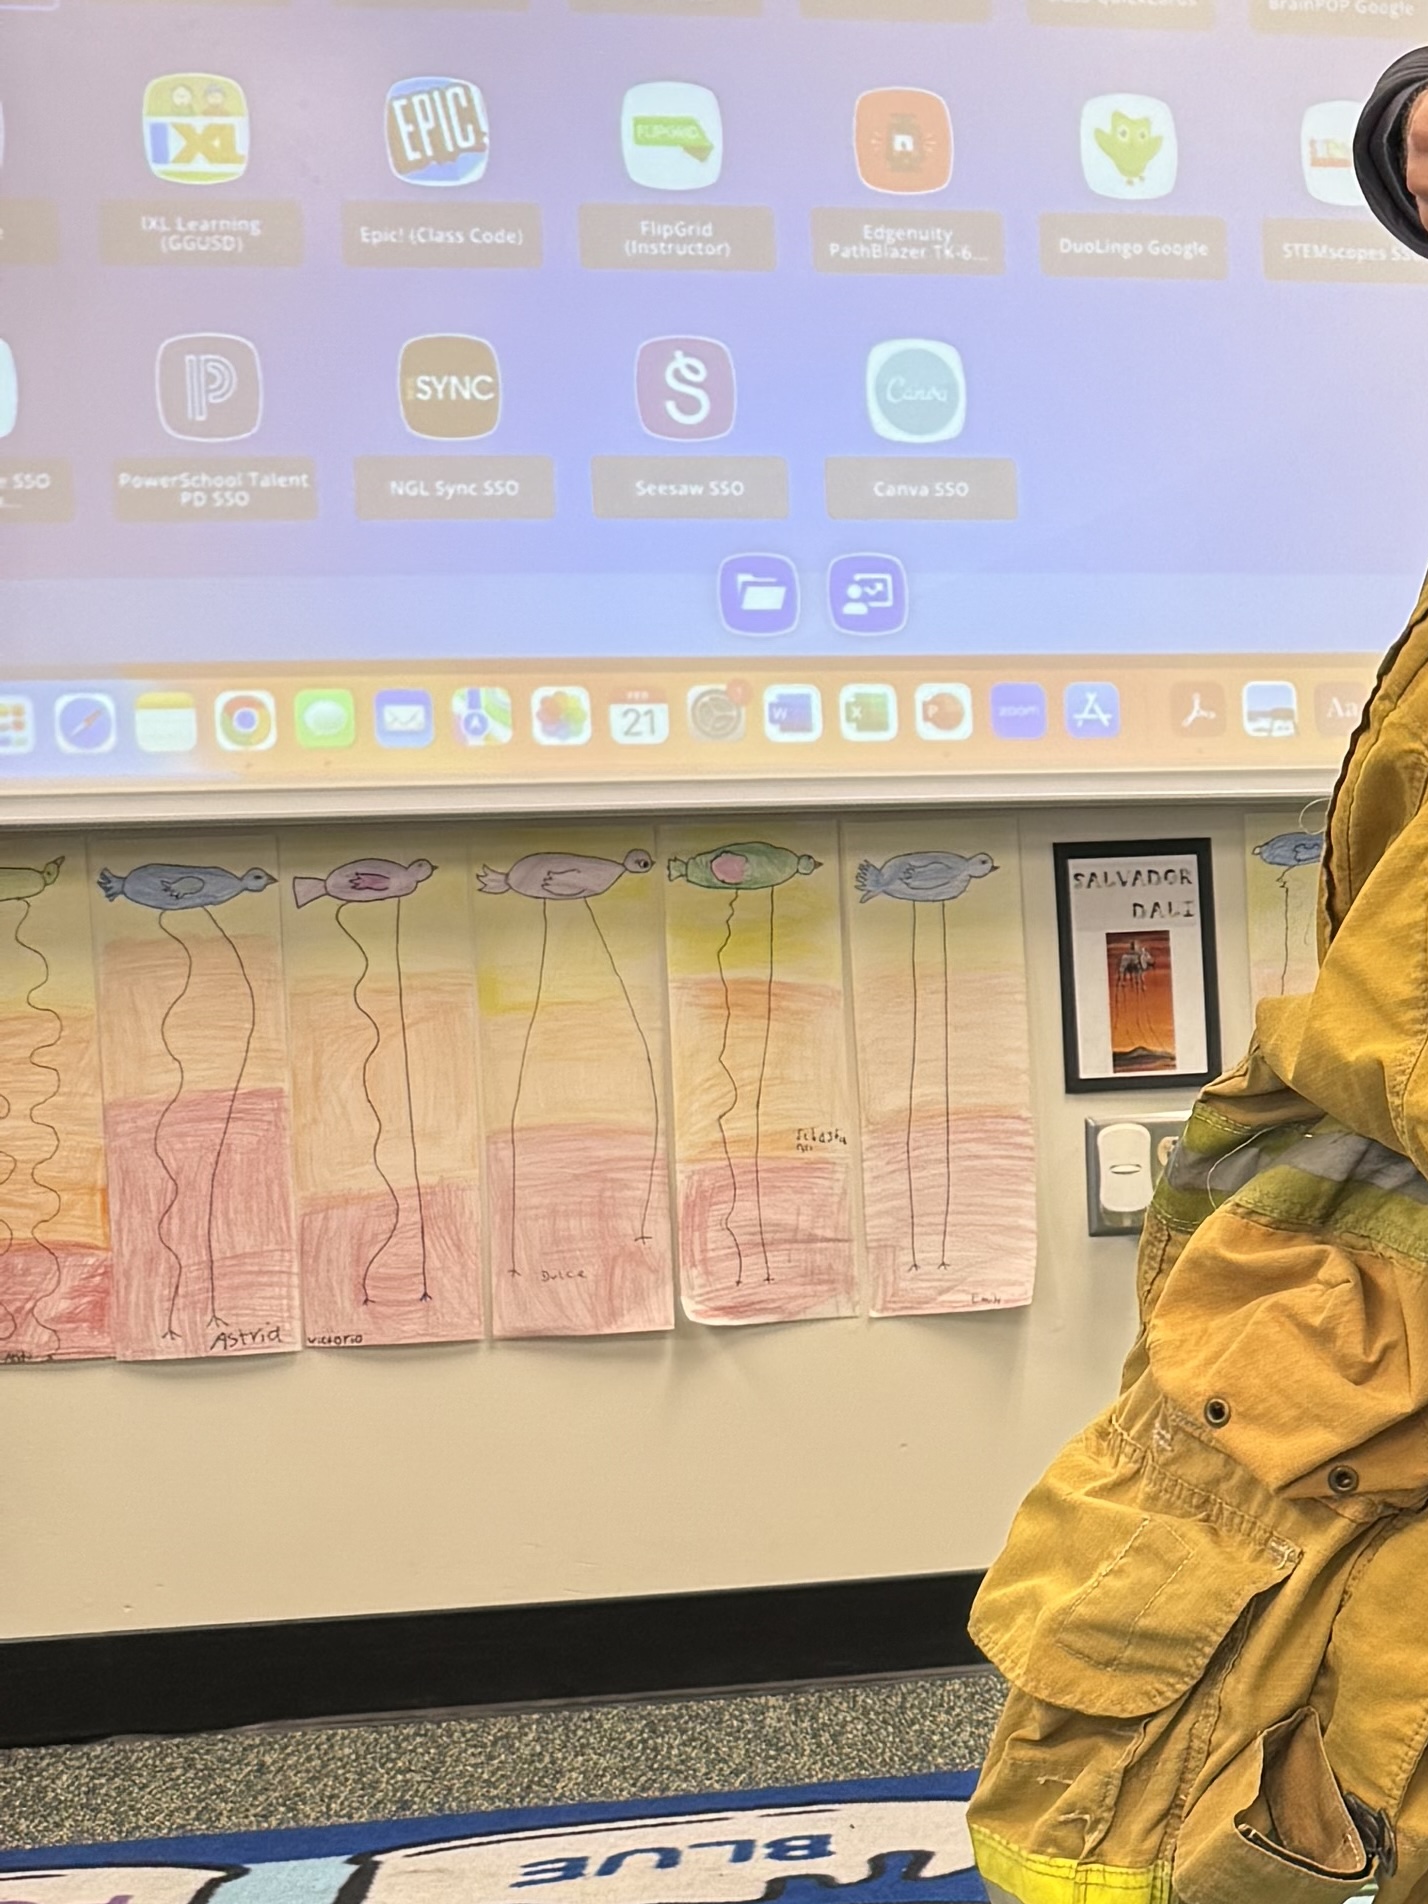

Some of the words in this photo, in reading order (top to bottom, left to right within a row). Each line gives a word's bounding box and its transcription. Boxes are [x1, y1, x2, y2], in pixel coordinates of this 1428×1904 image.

[394, 86, 488, 162] EPIC!
[416, 376, 494, 400] SYNC
[119, 472, 242, 489] PowerSchool
[249, 472, 308, 488] Talent
[635, 480, 704, 495] Seesaw
[710, 480, 744, 495] SSO
[1073, 868, 1193, 888] SALVADOR
[1133, 901, 1195, 919] DALI
[211, 1322, 281, 1350] Astrid
[521, 1835, 836, 1890] BLUE
